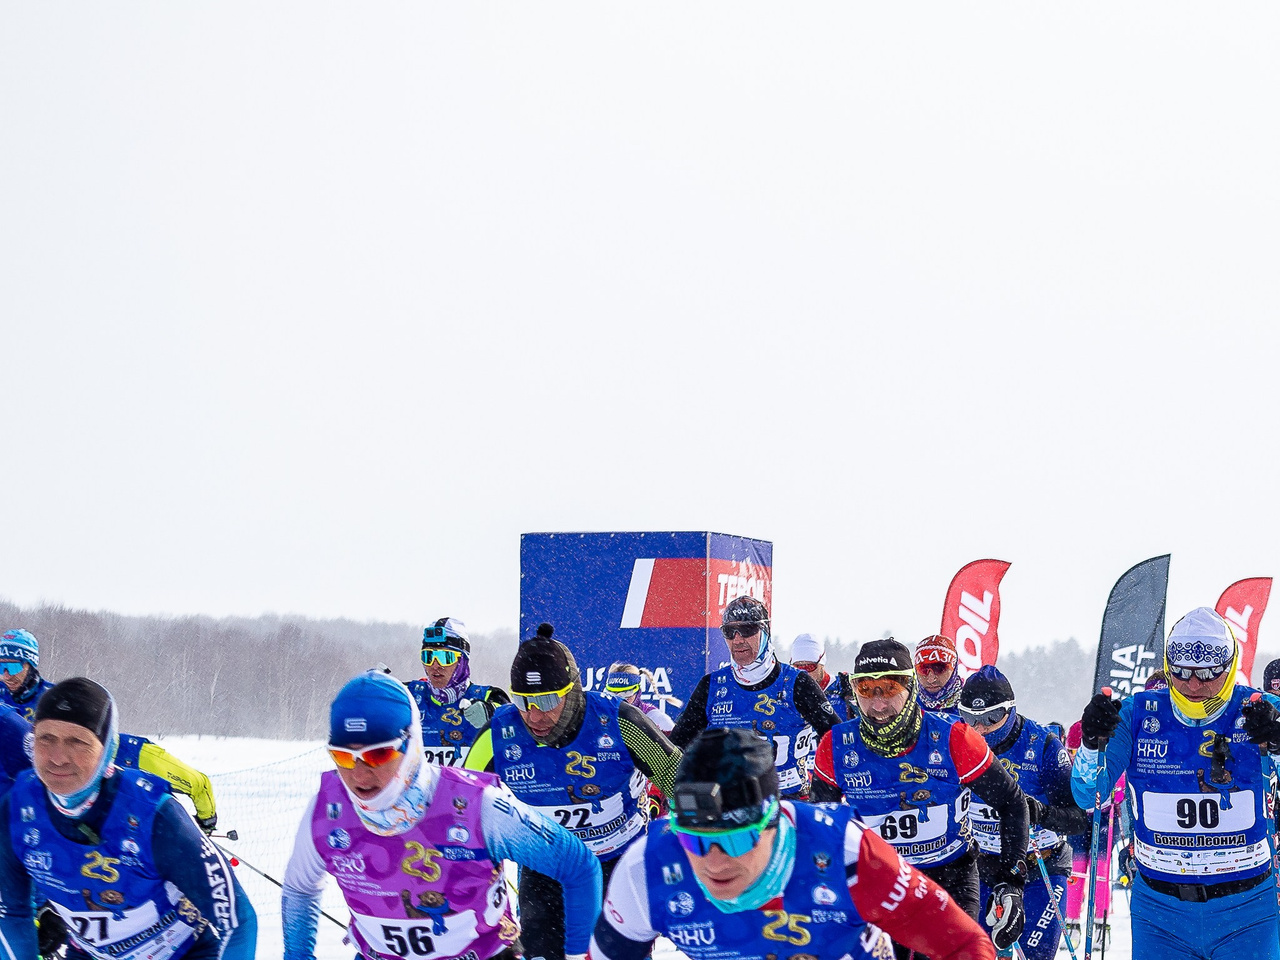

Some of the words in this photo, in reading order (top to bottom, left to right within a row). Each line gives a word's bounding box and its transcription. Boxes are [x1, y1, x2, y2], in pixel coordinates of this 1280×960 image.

[565, 751, 596, 778] 25
[555, 808, 592, 829] 22
[1177, 798, 1219, 829] 90
[880, 815, 918, 840] 69
[1154, 833, 1194, 846] Божок
[1196, 834, 1246, 847] Леонид
[912, 836, 947, 854] Сергей
[81, 851, 120, 883] 25
[402, 841, 443, 882] 25
[71, 917, 110, 943] 27
[381, 924, 436, 957] 56
[763, 910, 811, 946] 25
